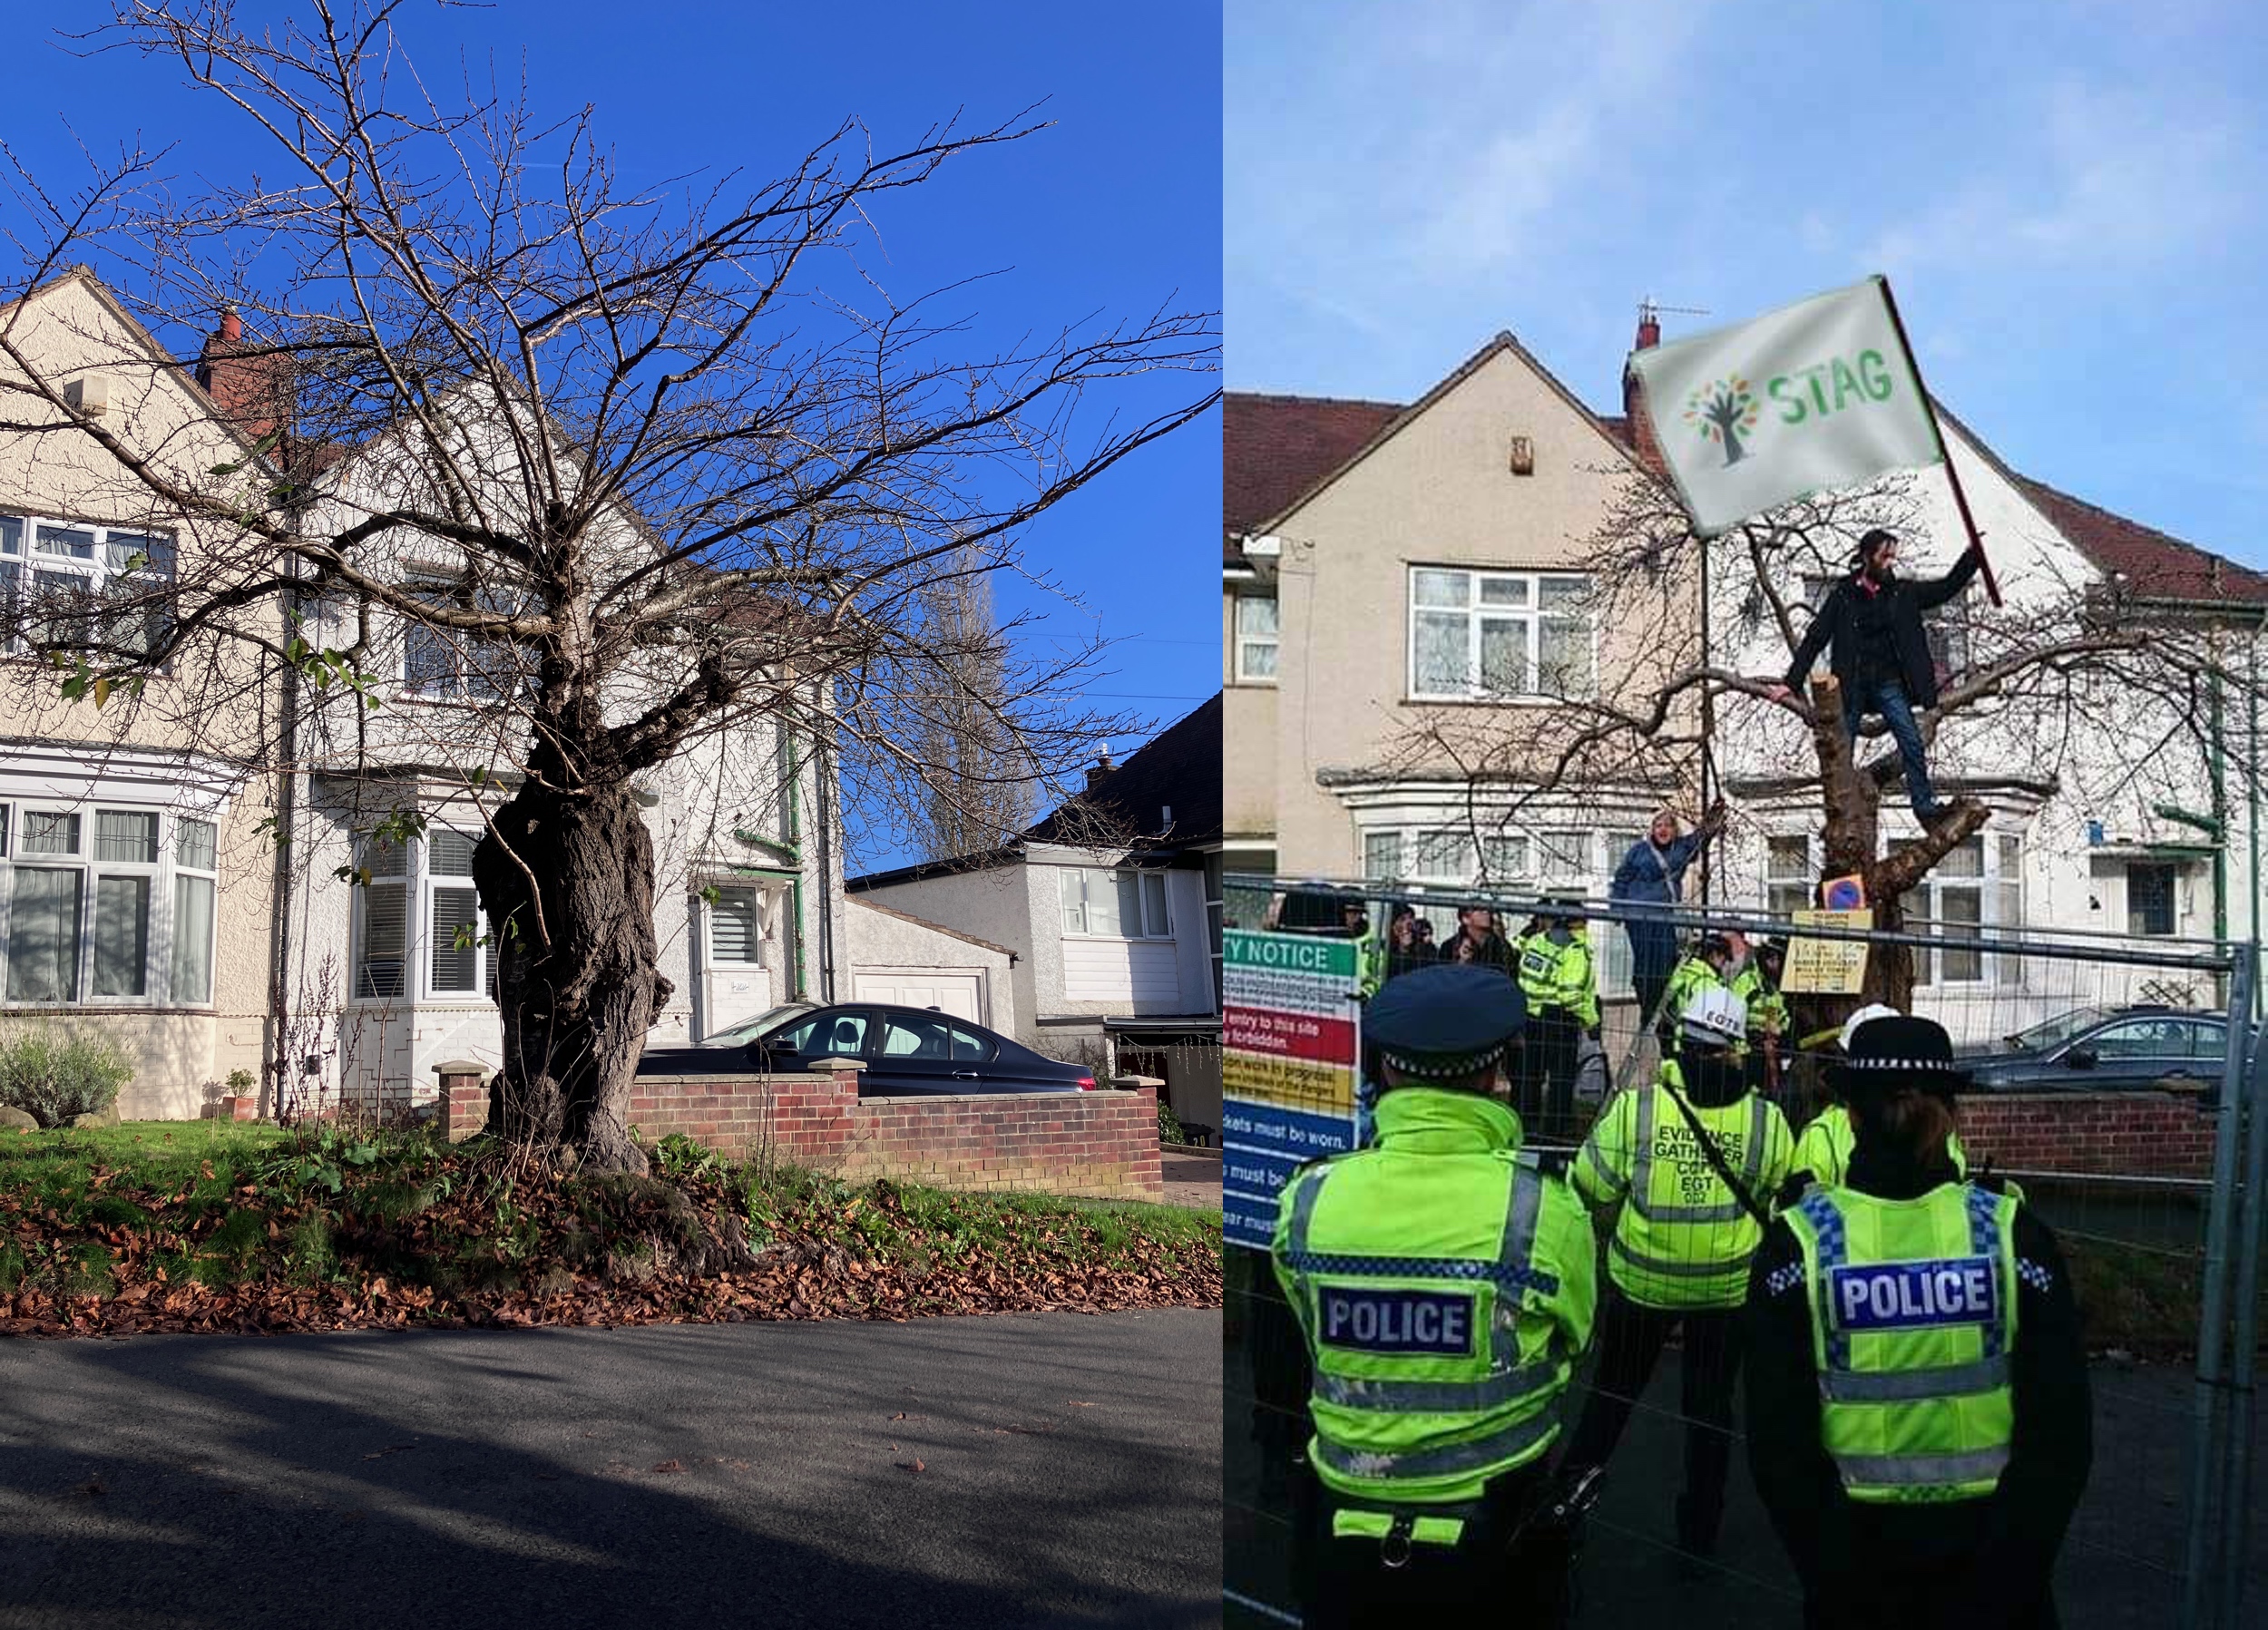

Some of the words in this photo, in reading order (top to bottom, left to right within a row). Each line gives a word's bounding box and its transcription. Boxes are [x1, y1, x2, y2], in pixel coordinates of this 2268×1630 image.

[1768, 349, 1892, 425] STAG
[1248, 941, 1328, 969] NOTICE
[1229, 1013, 1256, 1030] entry
[1258, 1014, 1272, 1030] to
[1297, 1020, 1319, 1037] site
[1254, 1121, 1286, 1139] must
[1289, 1126, 1305, 1142] be
[1309, 1132, 1346, 1149] worn.
[1231, 1166, 1265, 1185] must
[1681, 1176, 1713, 1192] EGT
[1843, 1268, 1989, 1321] POLICE
[1328, 1297, 1465, 1345] POLICE
